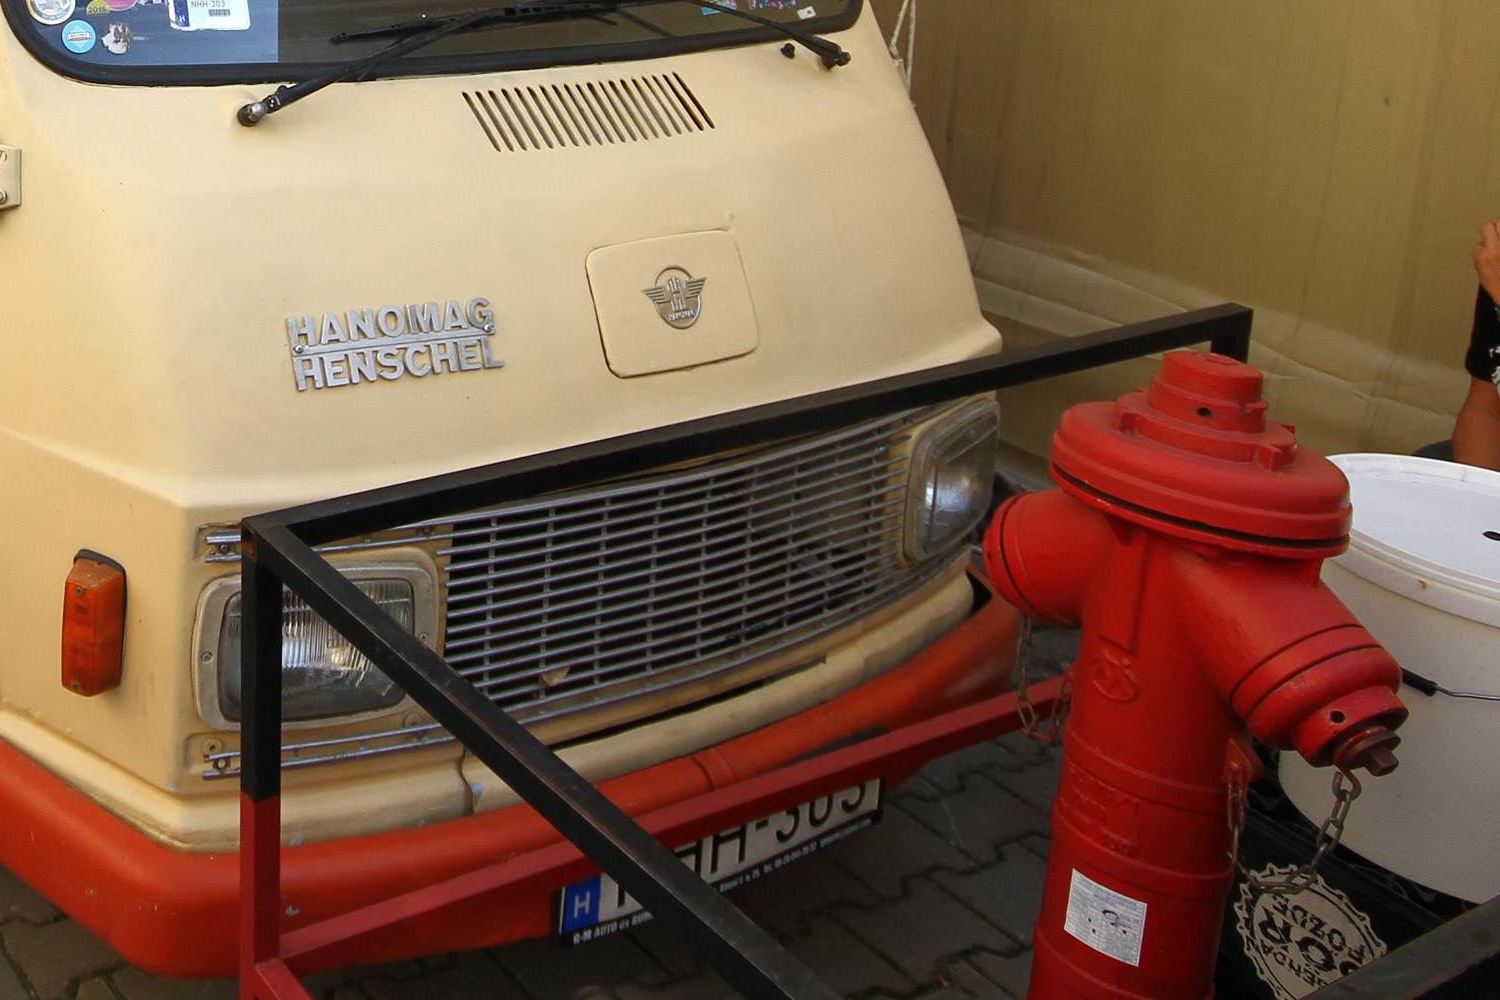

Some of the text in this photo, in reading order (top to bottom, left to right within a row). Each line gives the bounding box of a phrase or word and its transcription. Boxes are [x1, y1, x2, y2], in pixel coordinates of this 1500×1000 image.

[191, 0, 226, 8] NHH-303
[286, 297, 494, 347] HANOMAG
[292, 336, 505, 391] HENSCHEL
[574, 891, 591, 918] H
